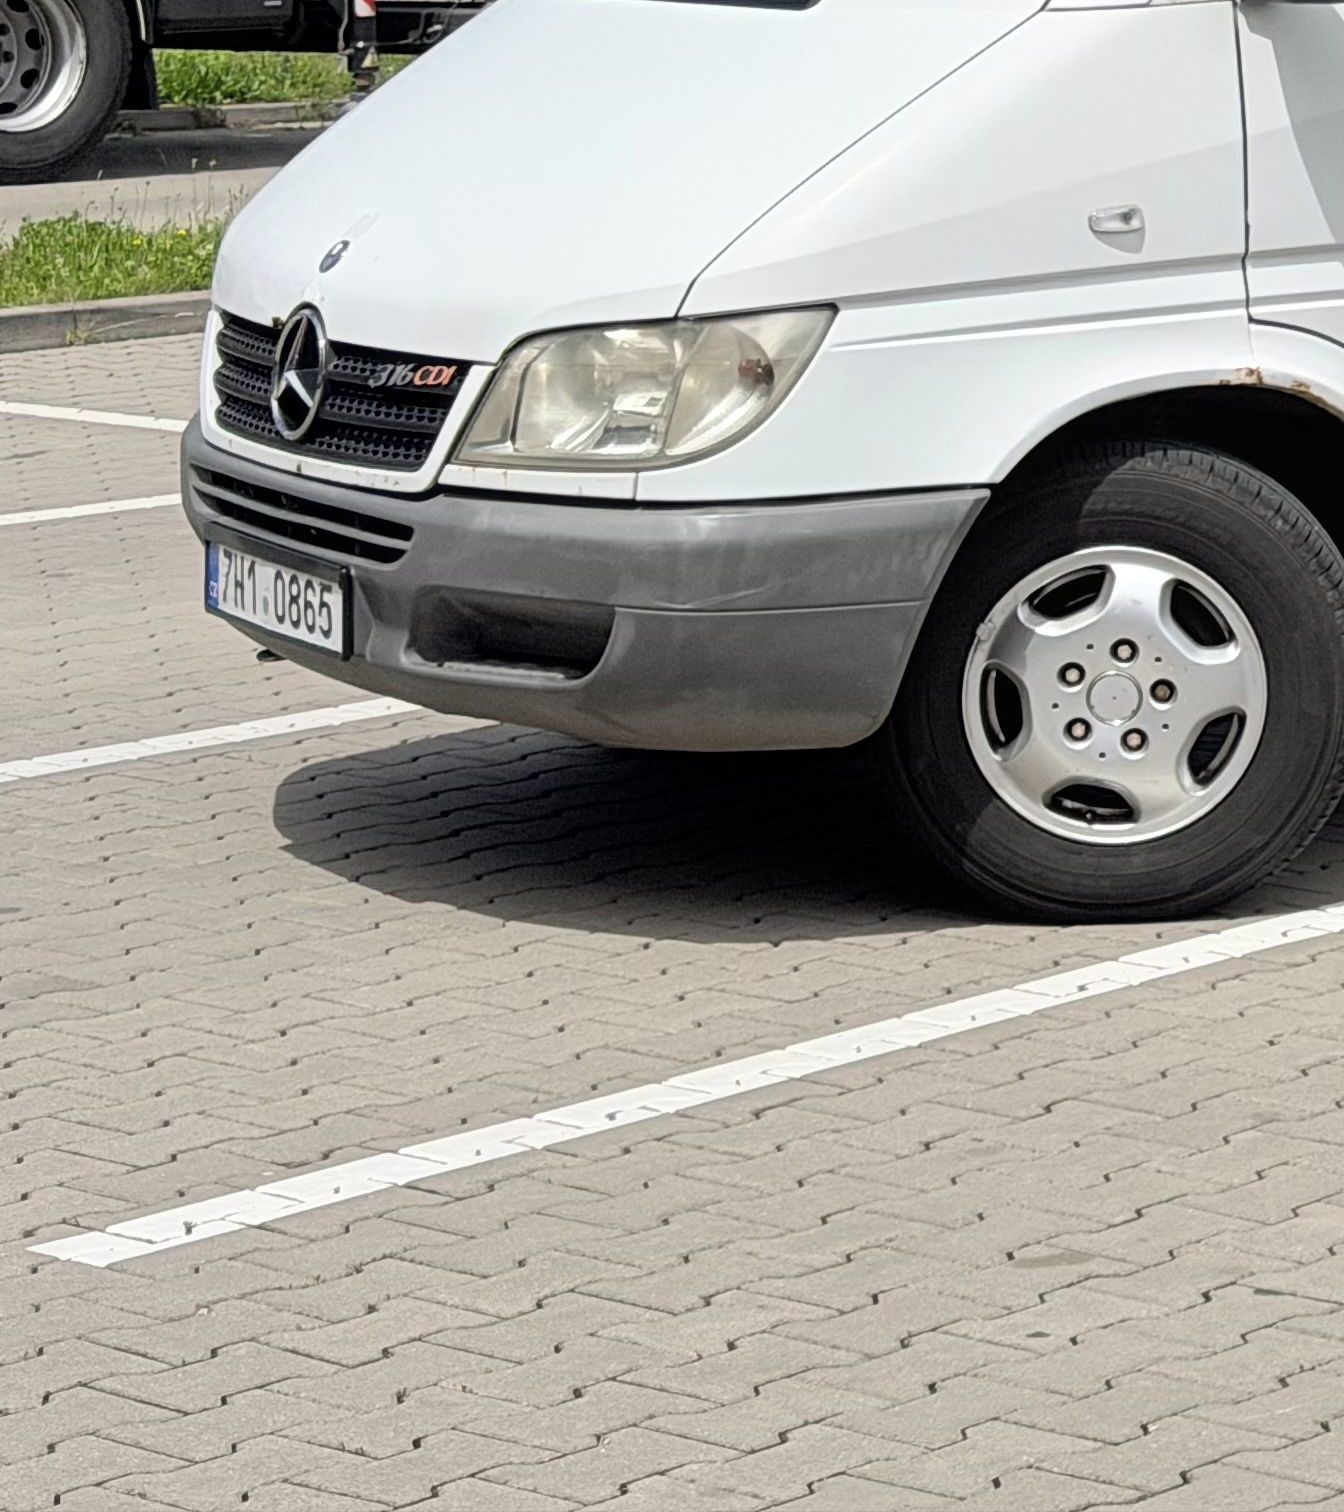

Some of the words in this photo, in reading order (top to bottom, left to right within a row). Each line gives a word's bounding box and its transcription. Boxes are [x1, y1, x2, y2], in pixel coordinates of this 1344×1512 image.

[368, 362, 417, 388] 316
[413, 364, 458, 386] CDI
[222, 547, 257, 616] 7H1
[273, 568, 333, 640] 0865
